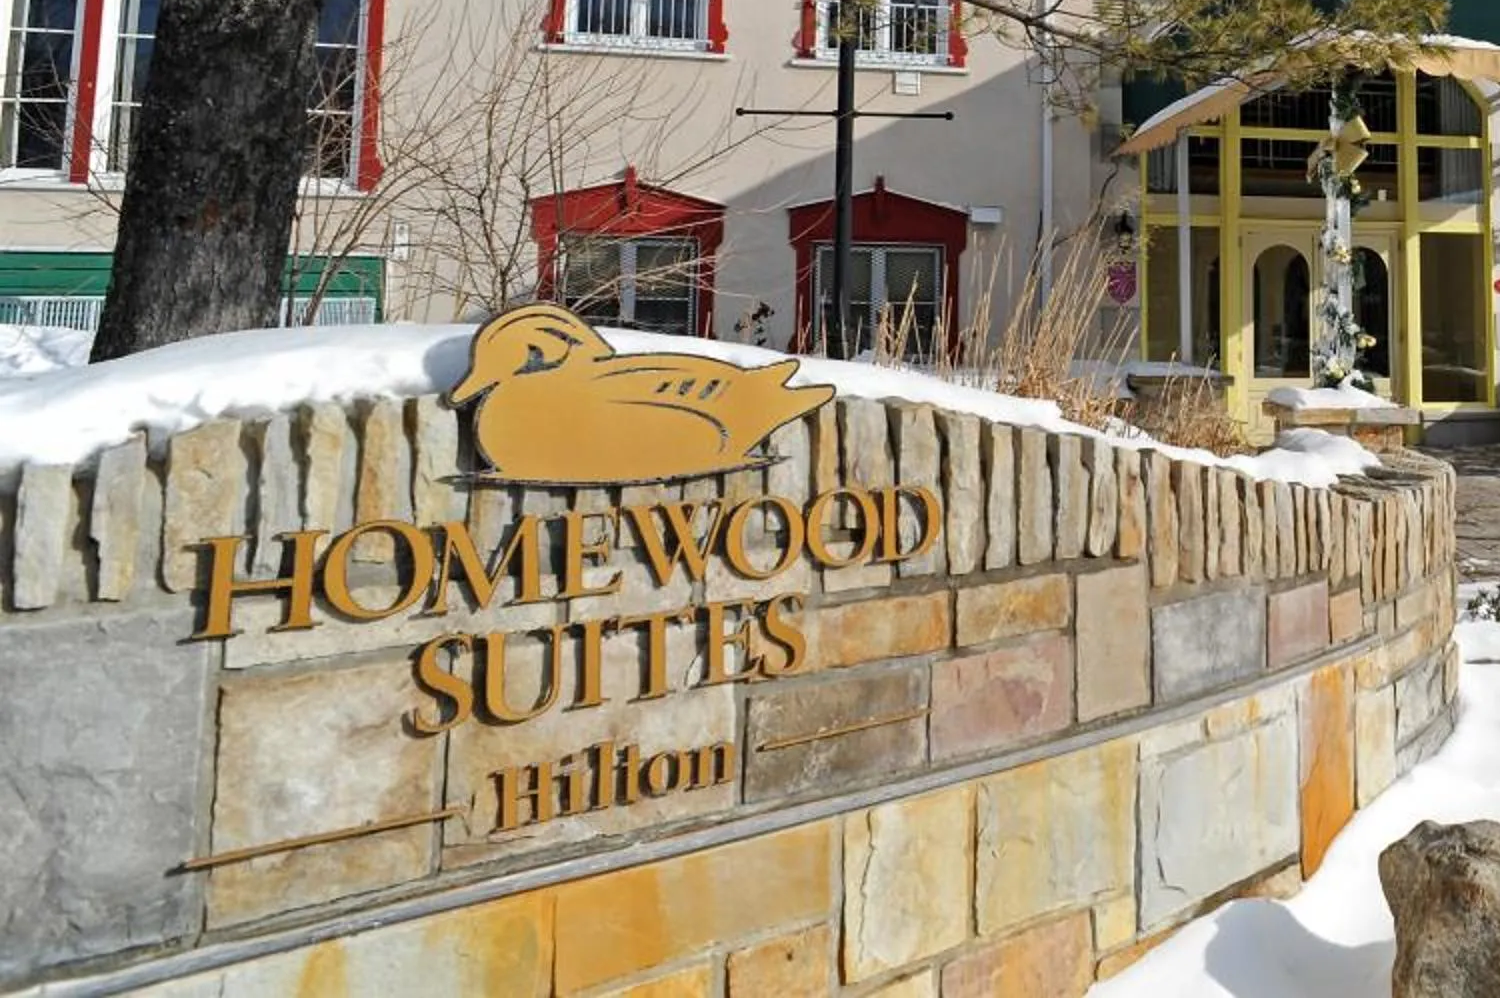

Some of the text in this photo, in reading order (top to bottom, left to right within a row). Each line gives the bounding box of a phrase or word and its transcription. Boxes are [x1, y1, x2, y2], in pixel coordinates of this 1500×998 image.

[186, 484, 944, 643] HOMEWOOD
[400, 595, 808, 737] SUITES
[486, 740, 736, 835] Hilton
